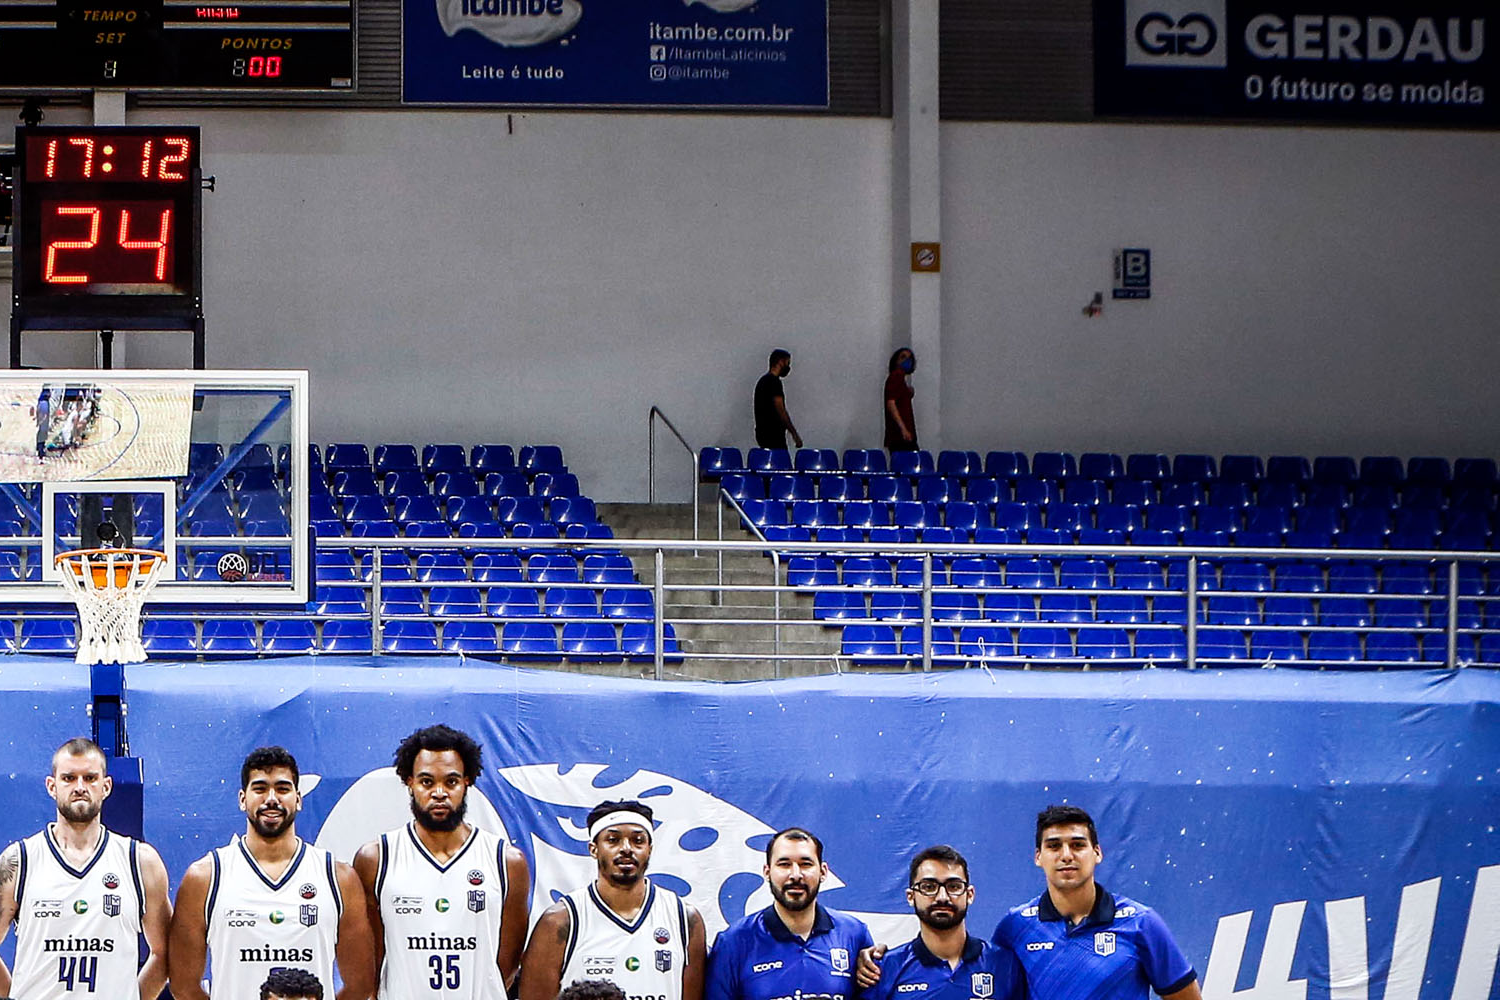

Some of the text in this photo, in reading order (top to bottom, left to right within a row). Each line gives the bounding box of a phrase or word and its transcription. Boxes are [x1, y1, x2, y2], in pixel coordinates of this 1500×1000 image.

[83, 10, 137, 22] TEMPO
[95, 32, 126, 44] SET
[649, 22, 794, 42] itambe.com.br
[1244, 14, 1485, 62] GERDAU
[221, 37, 293, 50] PONTOS
[462, 65, 565, 79] Leite é tudo
[668, 66, 730, 80] @itambe
[1245, 75, 1485, 104] O futuro se molda
[45, 138, 189, 180] 17:12
[45, 206, 170, 283] 24
[1127, 253, 1147, 276] B
[44, 934, 114, 952] minas
[407, 932, 477, 950] minas
[240, 943, 313, 962] minas
[58, 956, 98, 993] 44
[428, 954, 460, 990] 35
